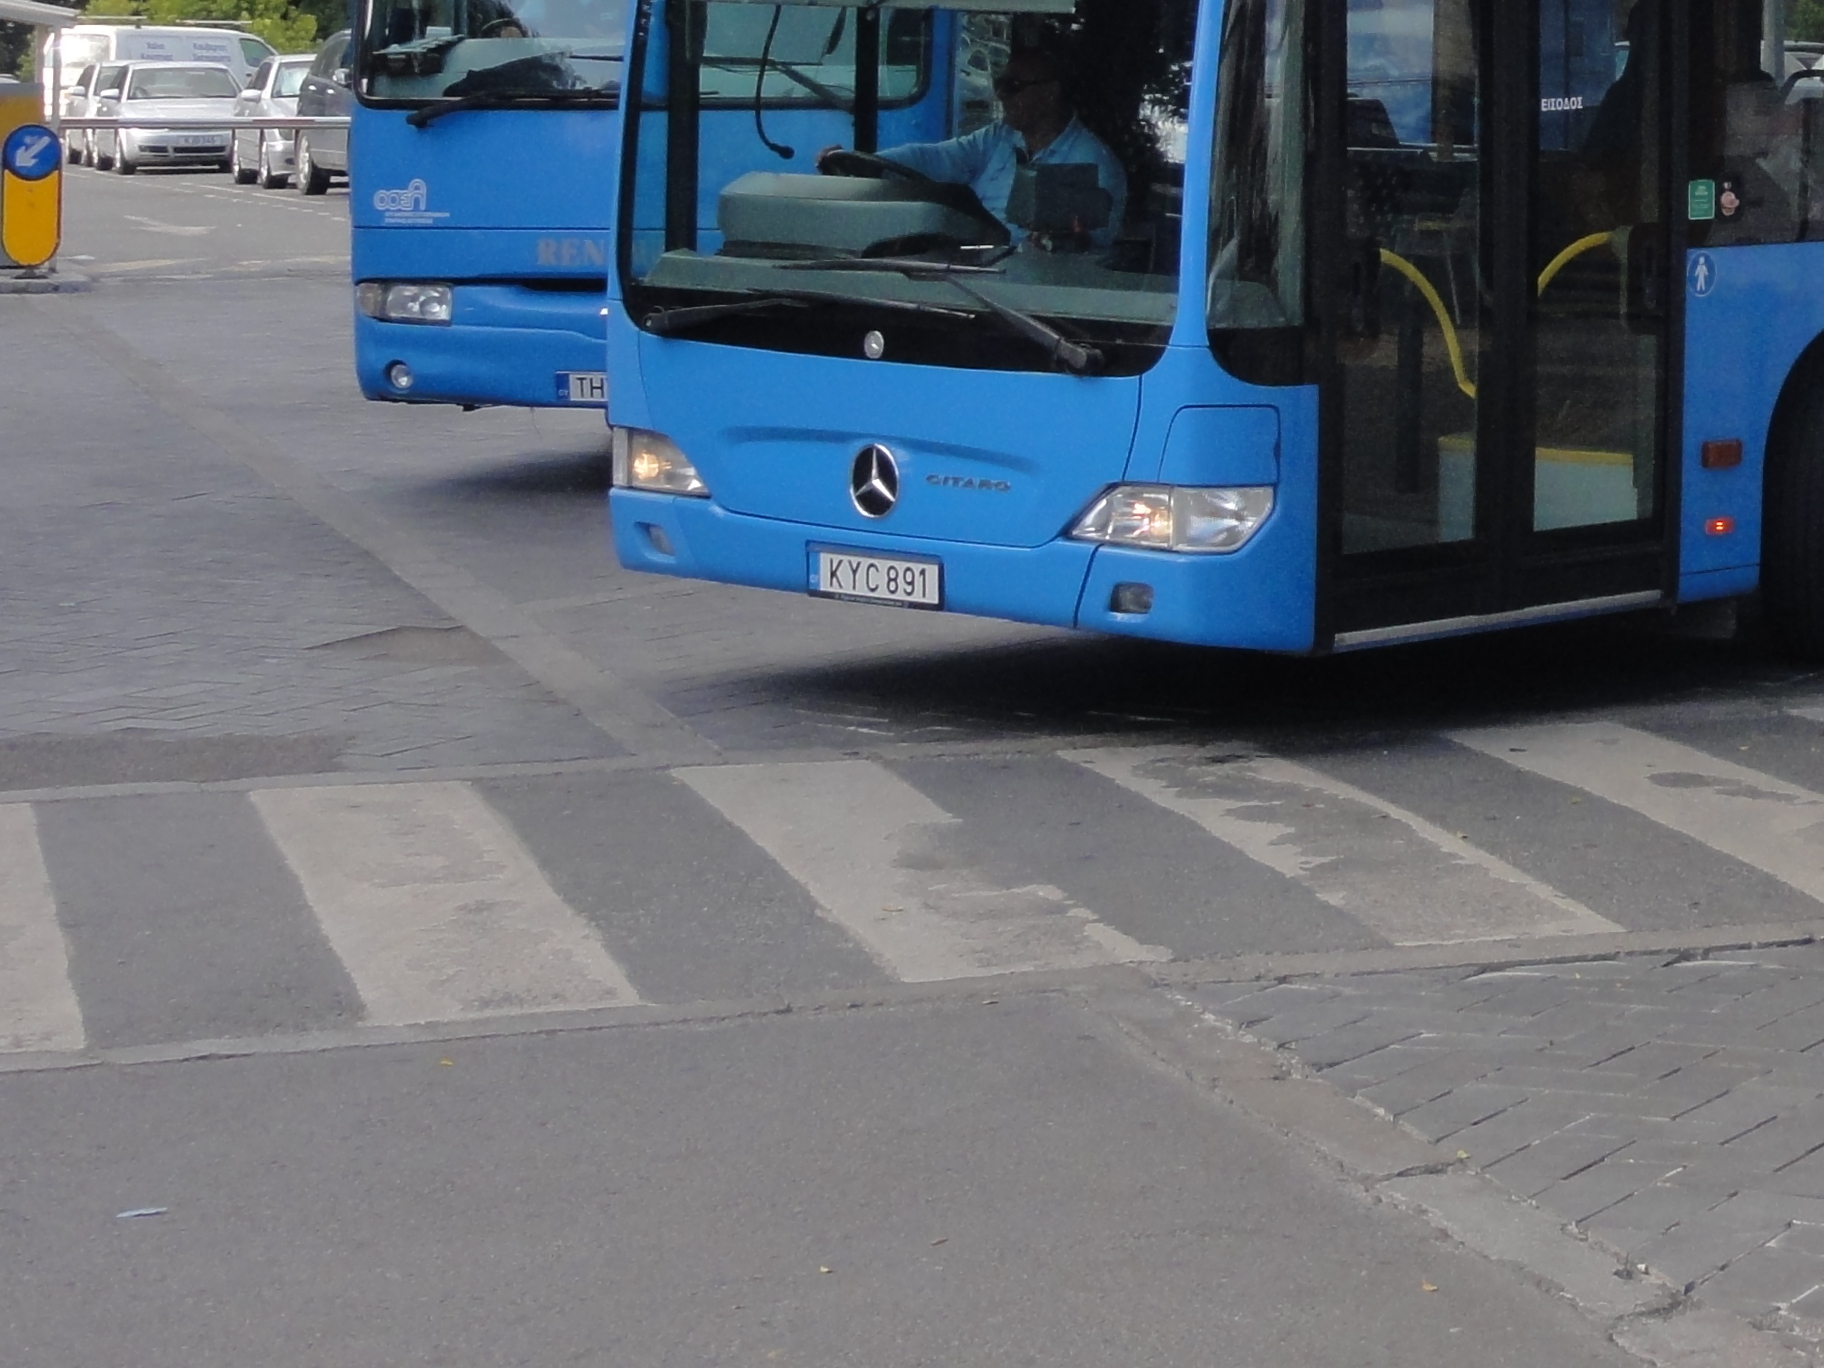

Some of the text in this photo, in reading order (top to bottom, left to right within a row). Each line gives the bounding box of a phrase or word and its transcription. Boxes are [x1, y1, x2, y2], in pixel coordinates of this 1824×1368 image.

[1540, 96, 1584, 112] ΕΙΣΟΔΟΣ
[537, 239, 606, 266] REN
[575, 377, 605, 399] TH
[925, 473, 1011, 493] CITARO
